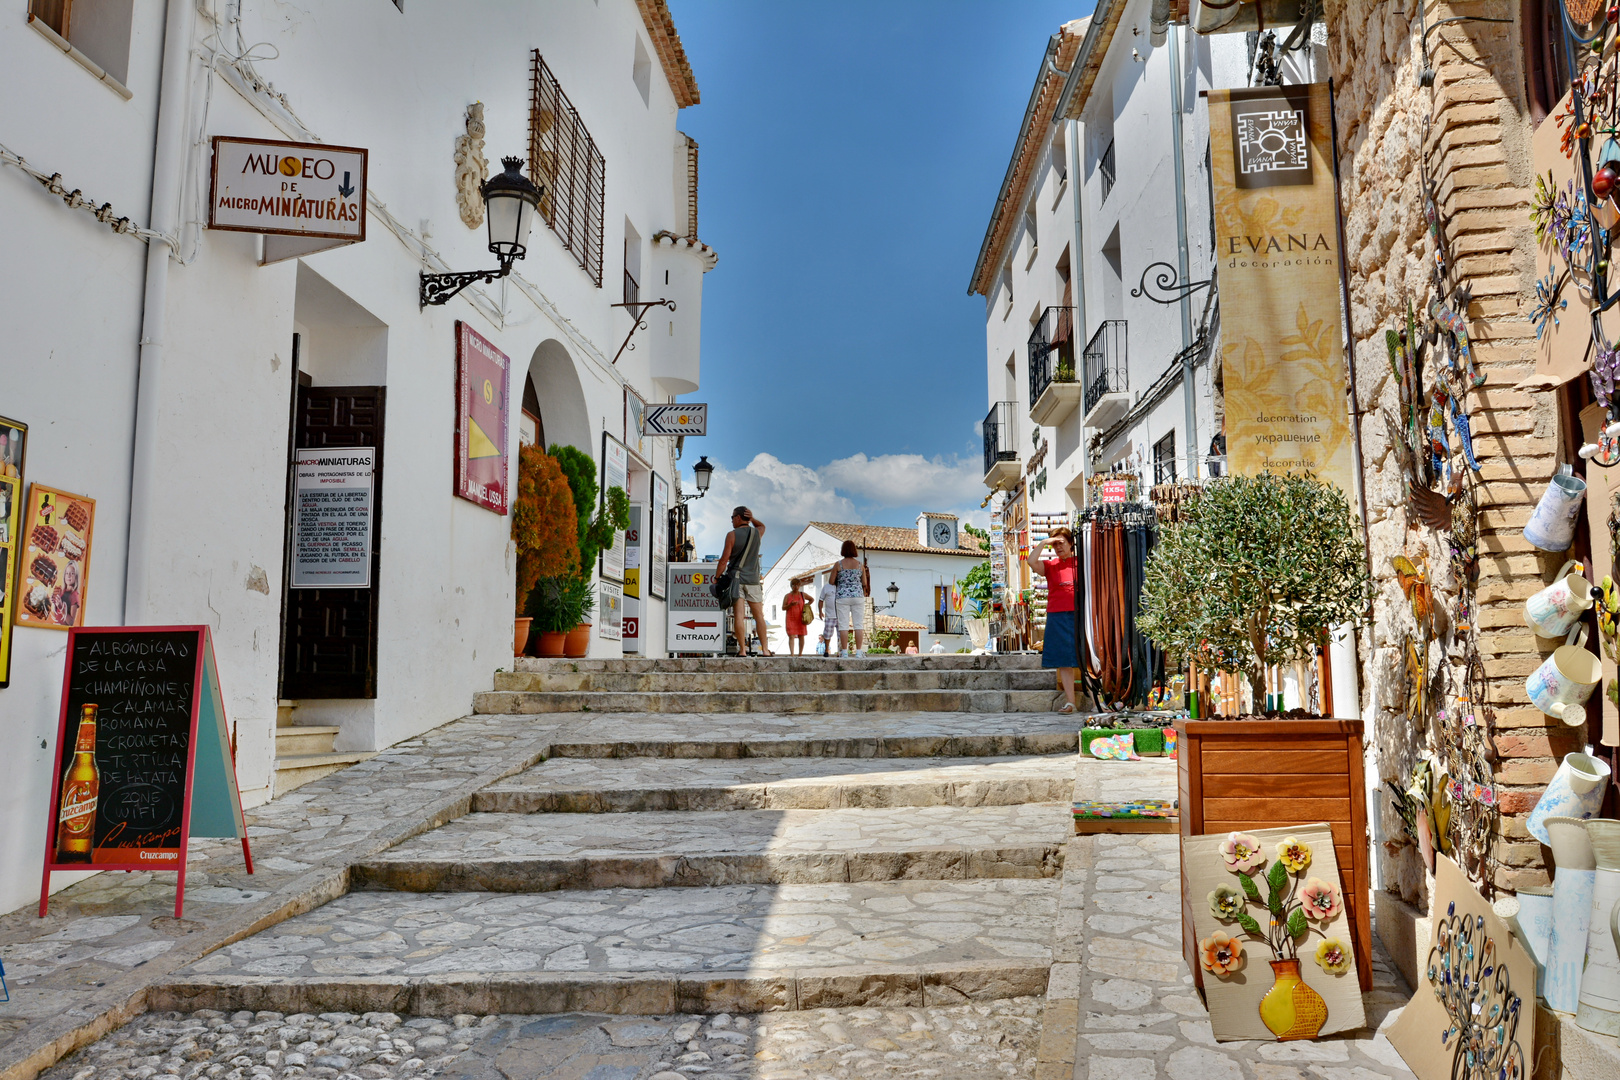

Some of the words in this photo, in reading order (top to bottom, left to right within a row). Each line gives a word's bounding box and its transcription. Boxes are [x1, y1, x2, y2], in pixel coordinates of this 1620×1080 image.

[242, 153, 335, 180] MUSEO
[1248, 156, 1273, 165] EVANA
[282, 182, 298, 192] DE
[1228, 233, 1331, 254] EVANA
[1229, 256, 1333, 268] decoración
[483, 344, 505, 370] MINIATURAS
[659, 414, 703, 425] MUSEO
[1256, 412, 1317, 423] decoration
[1255, 434, 1320, 445] украшение
[1262, 457, 1316, 468] decoratie
[468, 480, 488, 501] MANUEL
[489, 488, 502, 506] USSA
[603, 585, 619, 596] VISITE
[674, 599, 719, 607] MINIATURAS
[79, 661, 99, 674] DE
[85, 676, 190, 700] CHAMPIÑONES
[112, 700, 189, 717] CALAMAR
[100, 716, 167, 730] ROMANA
[108, 732, 189, 749] CROQUETAS
[103, 771, 121, 784] DE
[127, 770, 178, 784] PATATA
[120, 790, 161, 803] ZONE
[115, 803, 156, 819] WIFI
[140, 851, 178, 861] Cruzcampo
